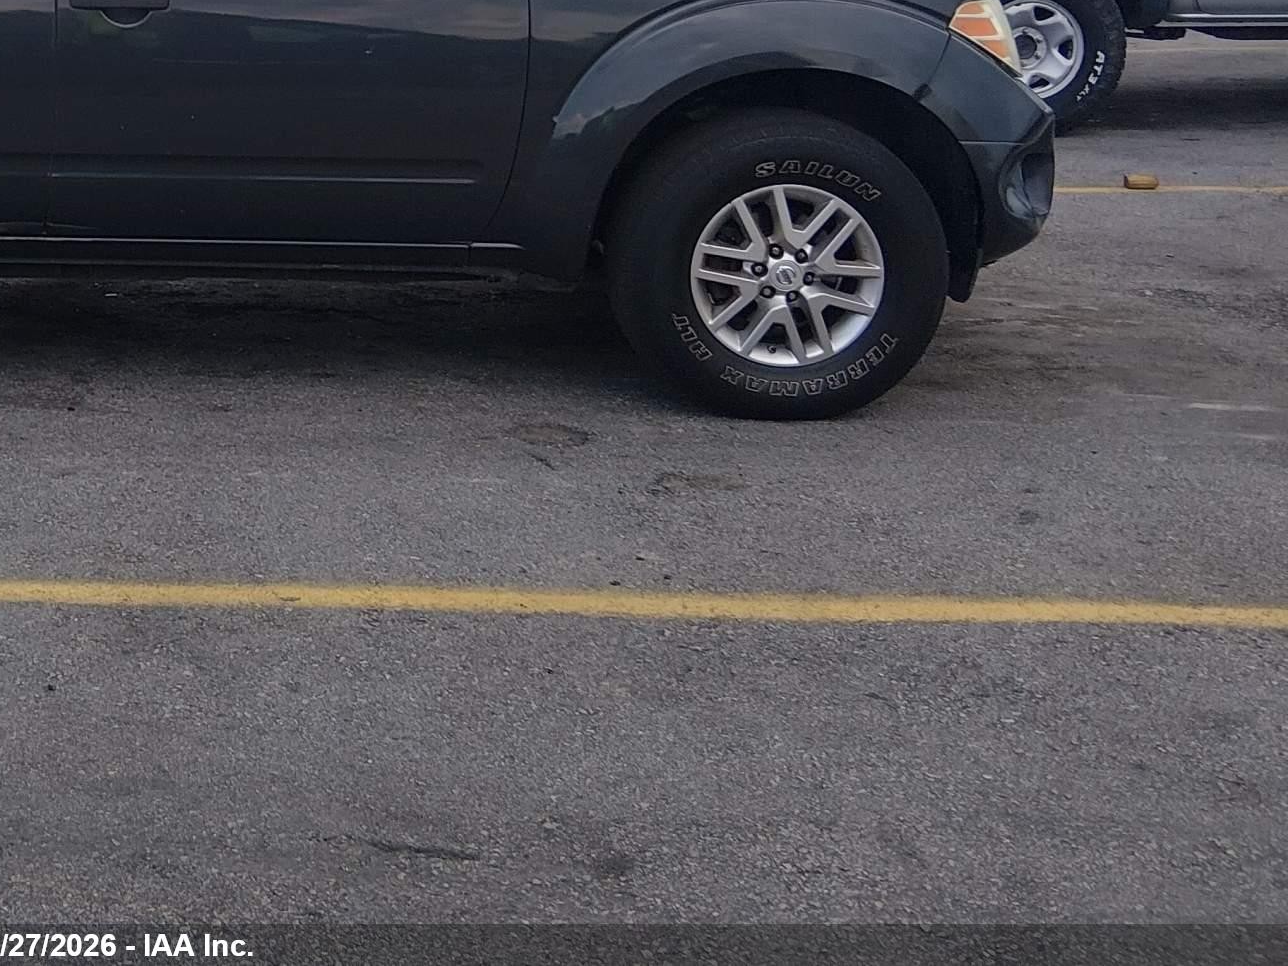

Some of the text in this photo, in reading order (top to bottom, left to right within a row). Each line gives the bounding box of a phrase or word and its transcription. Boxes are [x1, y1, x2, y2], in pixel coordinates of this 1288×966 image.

[1087, 50, 1106, 85] AT3
[755, 159, 882, 202] SAILUN
[671, 313, 899, 397] TERRAMAX HLT
